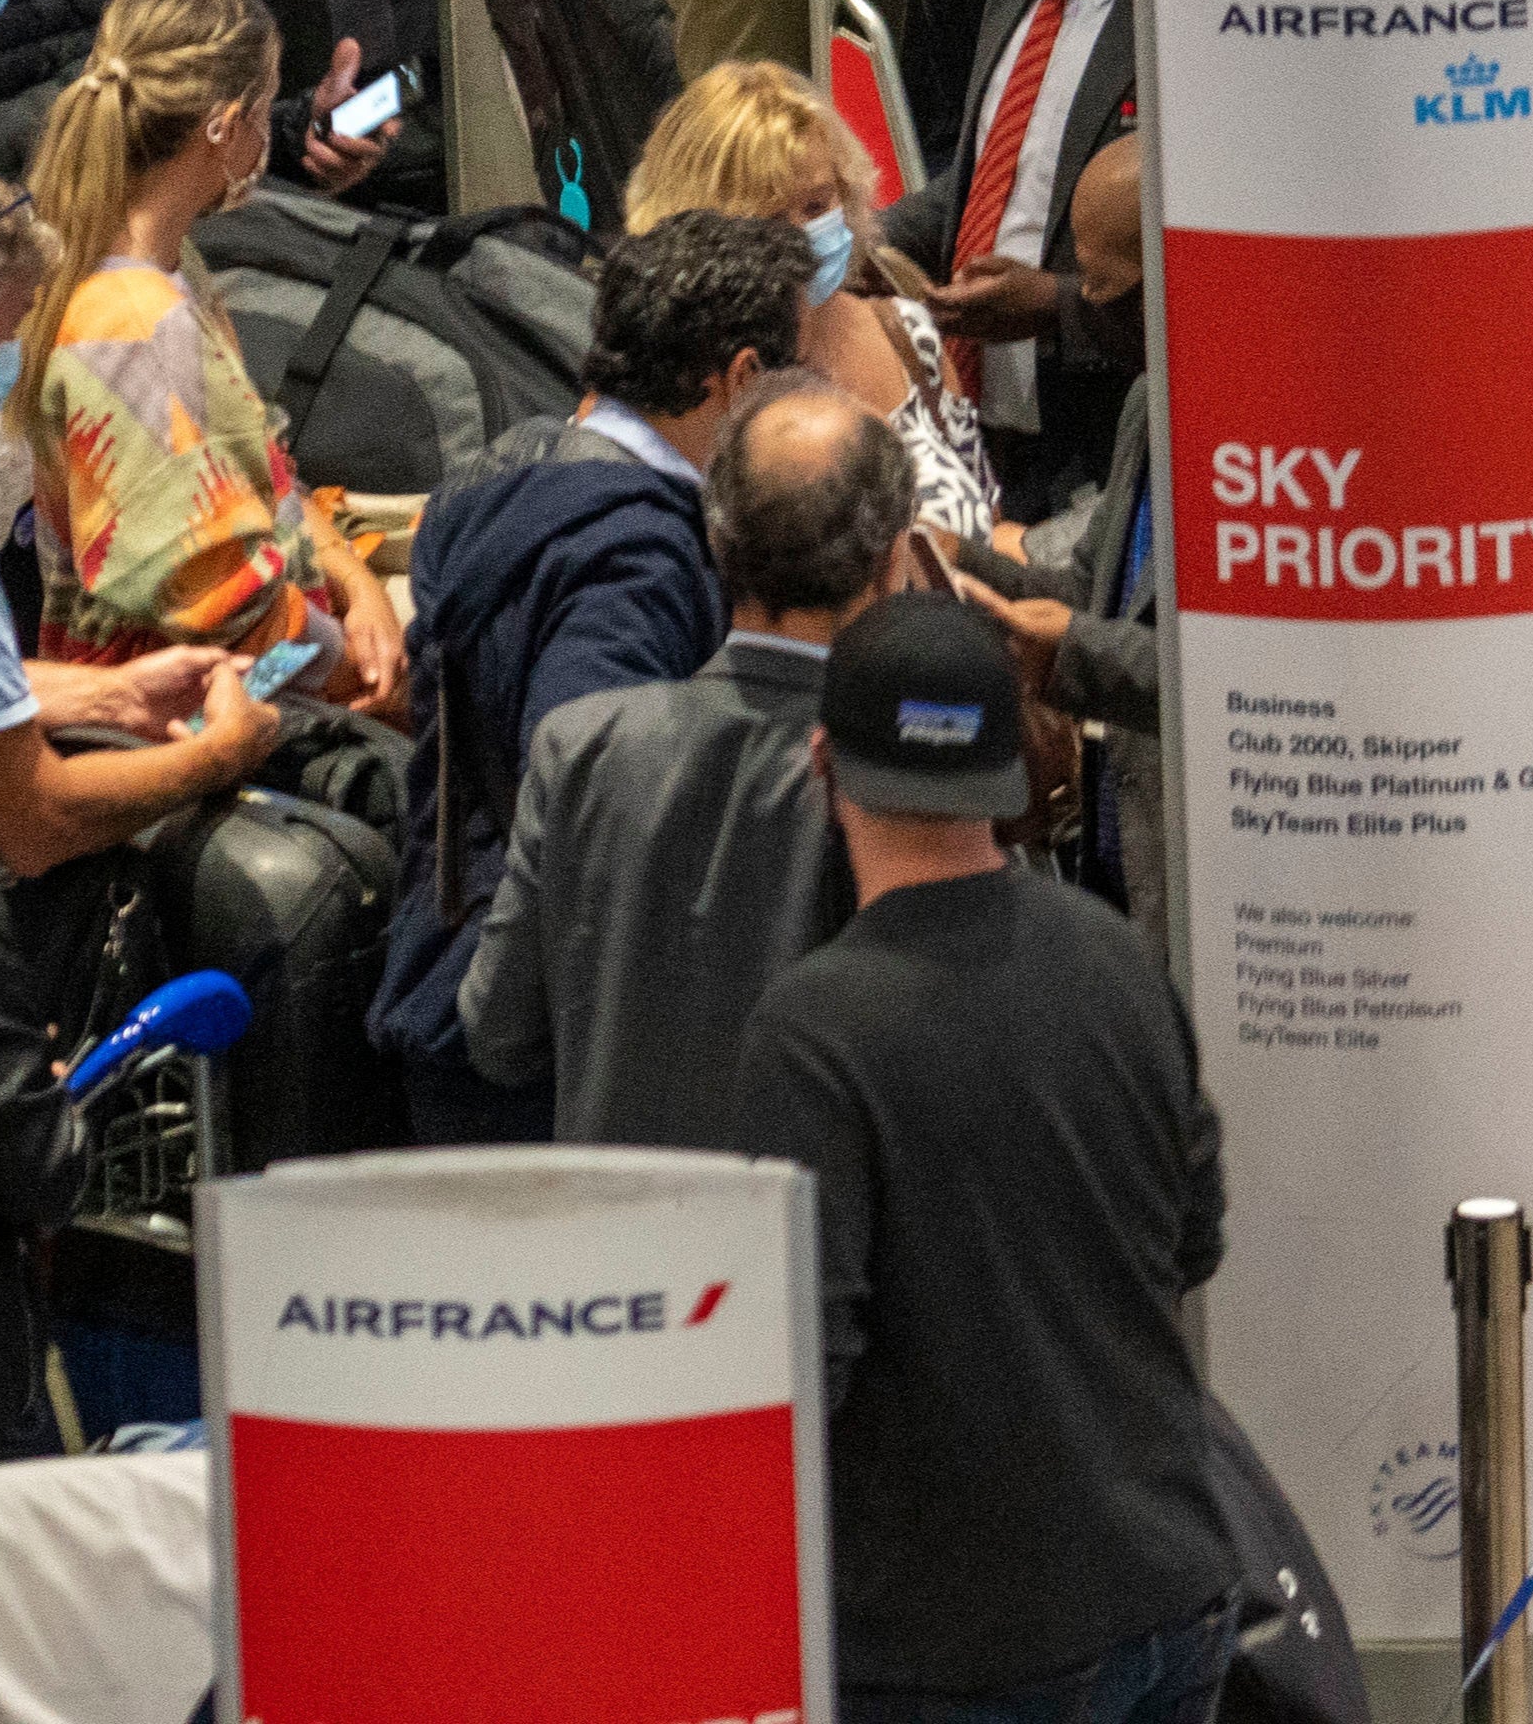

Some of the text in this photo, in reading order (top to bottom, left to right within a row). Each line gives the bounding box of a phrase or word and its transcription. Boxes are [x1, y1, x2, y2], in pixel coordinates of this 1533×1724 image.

[1414, 85, 1532, 126] KLM
[1211, 441, 1363, 511] SKY
[1226, 689, 1337, 718] Business
[1227, 728, 1463, 761] Club 2000, Skipper
[1228, 766, 1299, 798] Flying
[1306, 771, 1364, 797] Blue
[1370, 769, 1485, 797] Platinum
[1492, 767, 1511, 791] &
[1230, 805, 1467, 837] SkyTeam Elite Plus
[1236, 959, 1295, 990] Flying
[1299, 964, 1347, 989] Blue
[1237, 989, 1296, 1021] Flying
[1301, 995, 1348, 1020] Blue
[276, 1290, 667, 1341] AIRFRANCE
